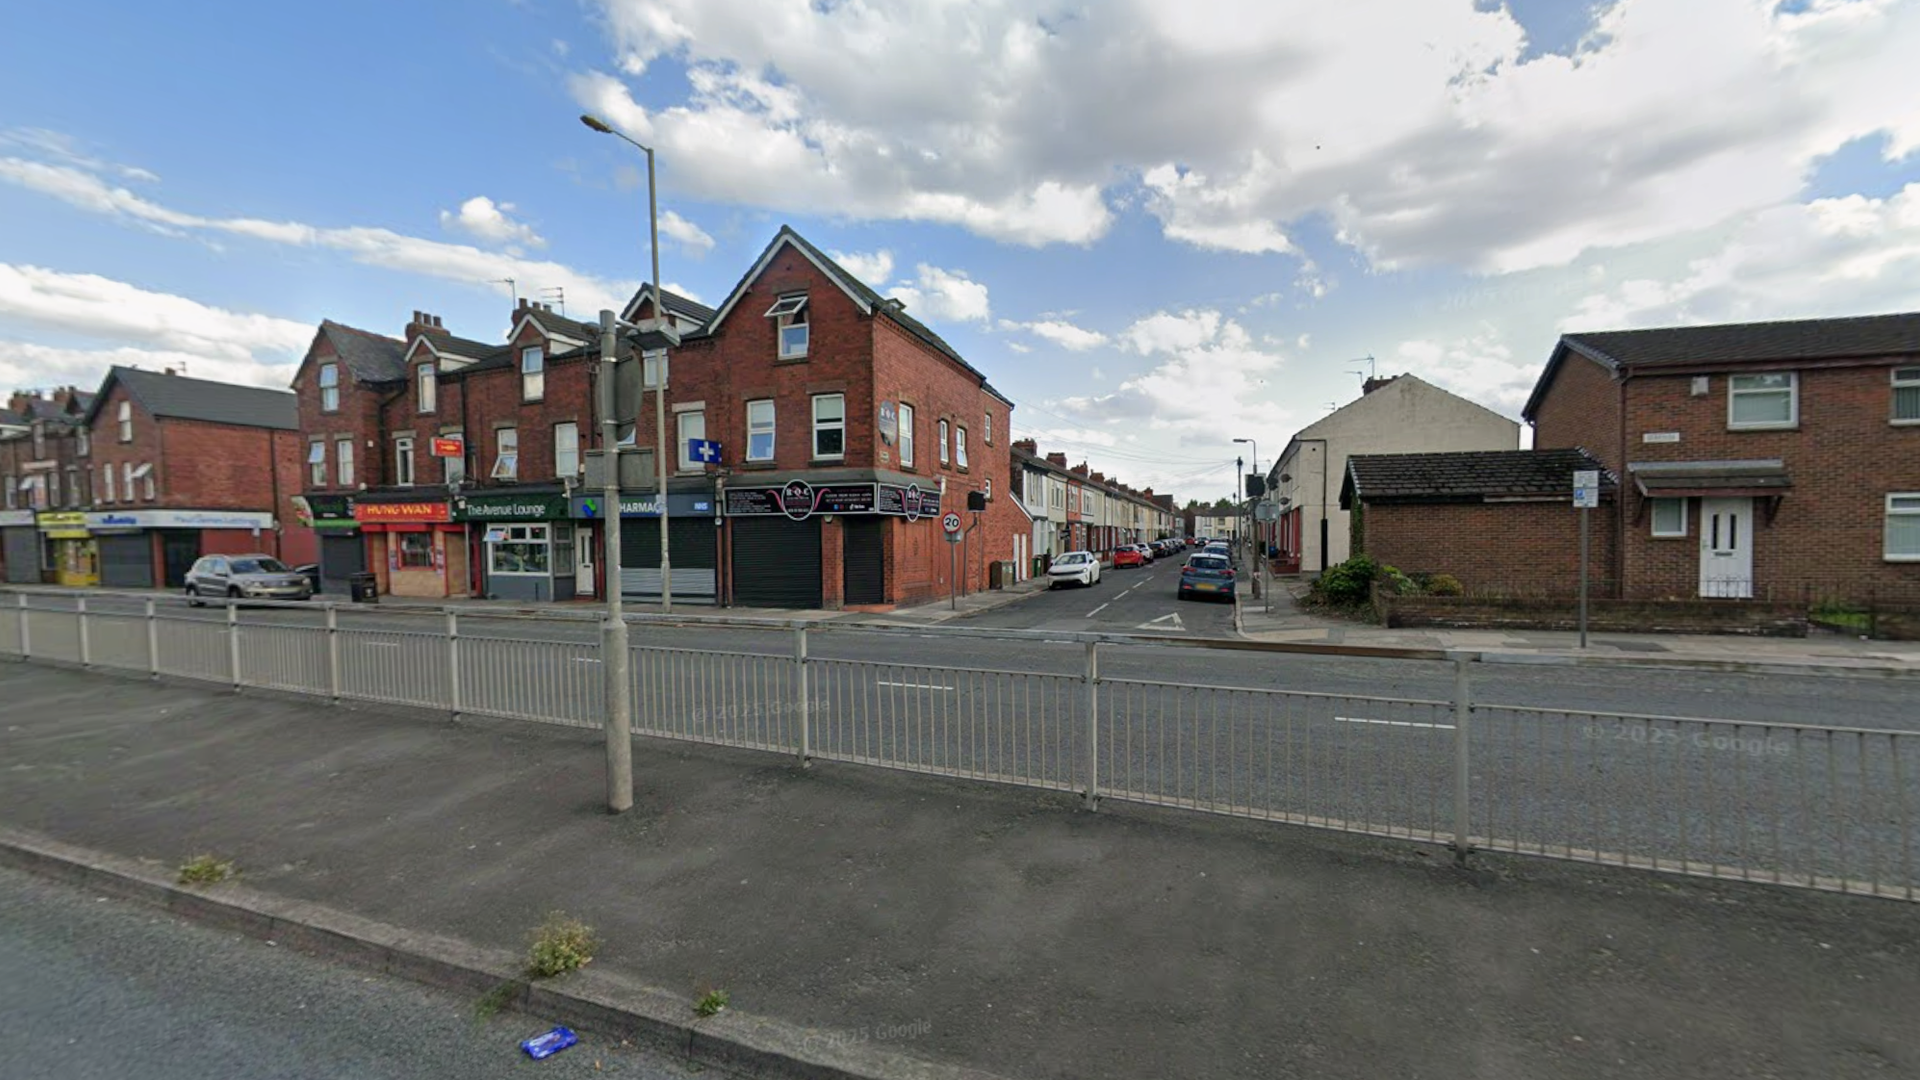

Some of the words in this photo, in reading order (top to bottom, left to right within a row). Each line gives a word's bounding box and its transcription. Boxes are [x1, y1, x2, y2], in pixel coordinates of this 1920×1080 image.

[367, 504, 400, 515] HUNG
[401, 504, 432, 515] WAN
[466, 504, 482, 516] The
[482, 504, 512, 516] Avenue
[513, 503, 546, 518] Lounge
[618, 502, 662, 514] HARMAC
[945, 517, 959, 528] 20
